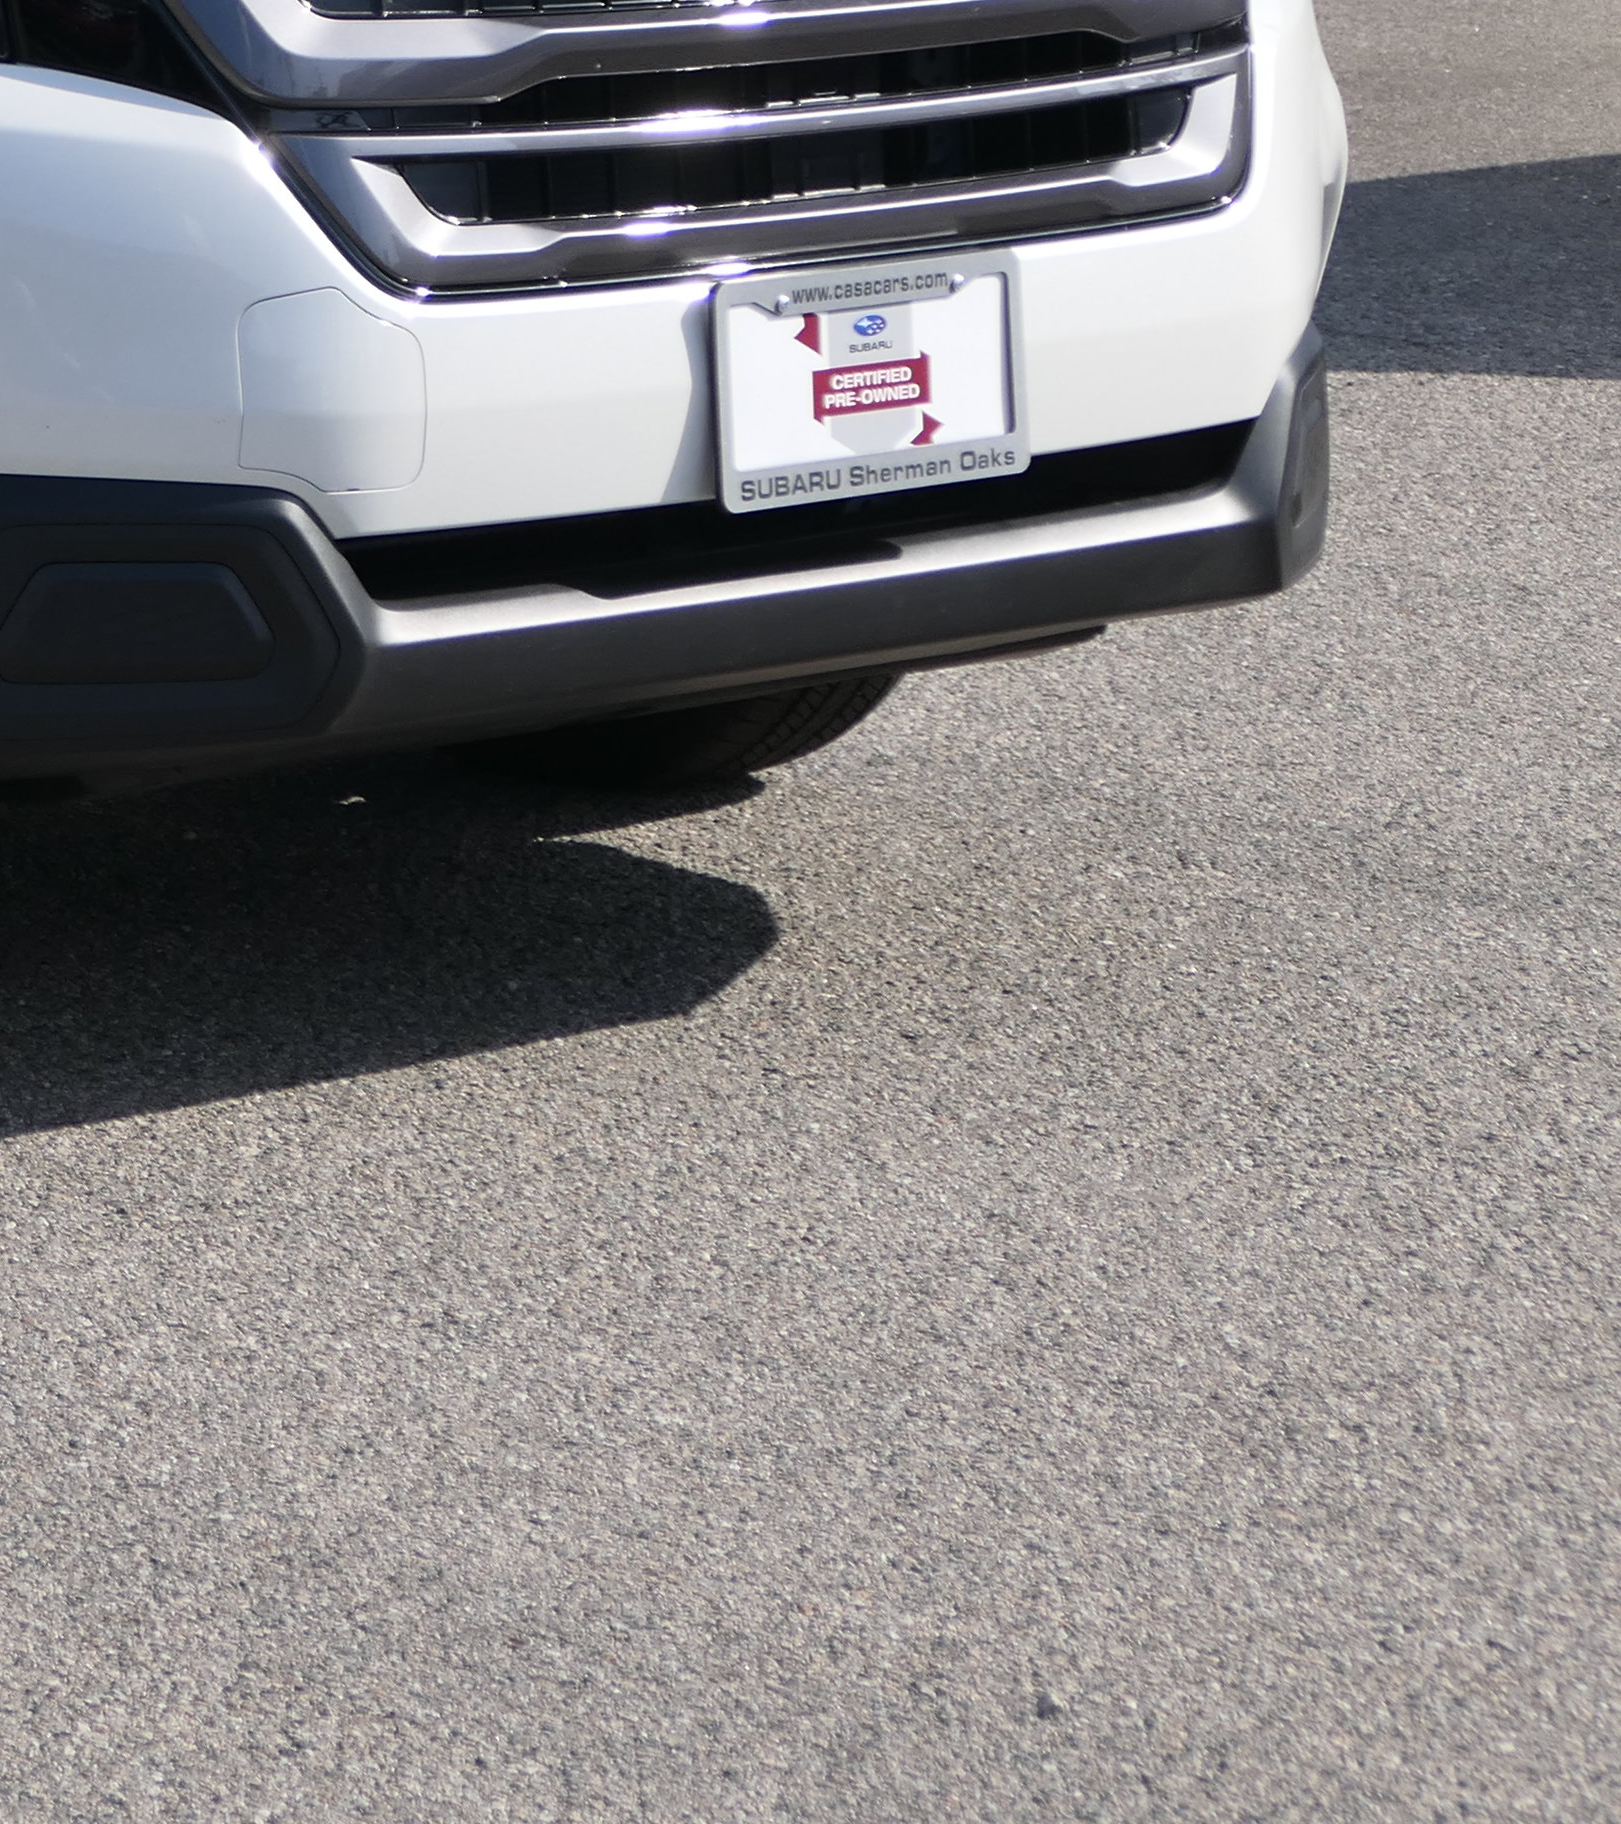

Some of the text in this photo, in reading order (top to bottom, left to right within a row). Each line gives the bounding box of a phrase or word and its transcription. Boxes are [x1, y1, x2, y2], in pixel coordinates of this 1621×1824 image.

[791, 271, 949, 305] www.casacars.com
[848, 340, 893, 353] SUBARU
[830, 366, 913, 390] CERTIFIED
[823, 383, 921, 410] PRE-OWNED
[740, 448, 1016, 502] SUBARU Sherman Oaks
